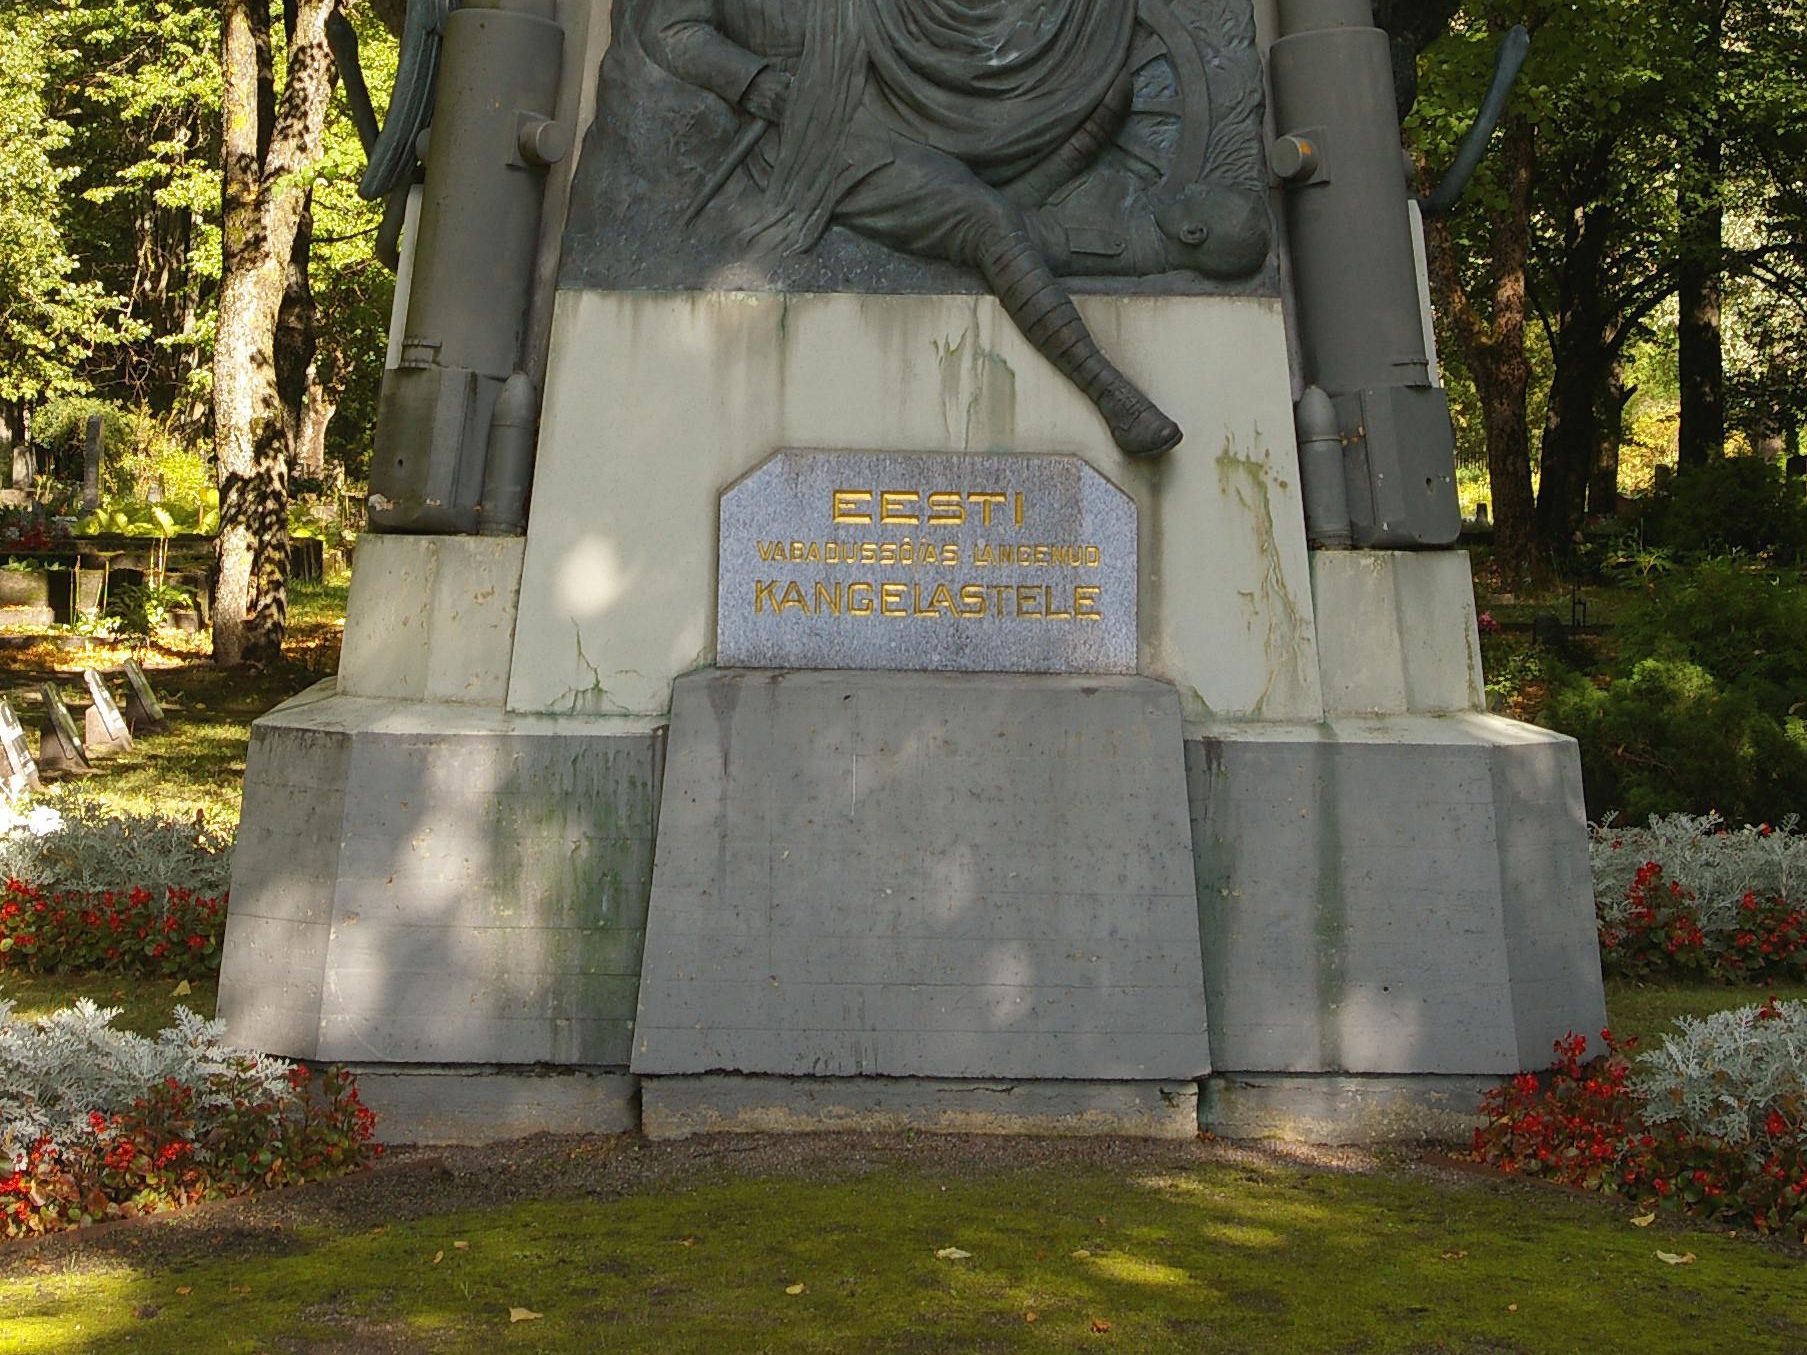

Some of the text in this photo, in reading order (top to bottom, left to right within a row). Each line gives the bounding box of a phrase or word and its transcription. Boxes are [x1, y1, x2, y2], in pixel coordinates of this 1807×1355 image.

[831, 488, 1025, 528] EESTI
[973, 543, 1101, 568] LANGENUD
[754, 579, 1103, 621] KANGELASTELE
